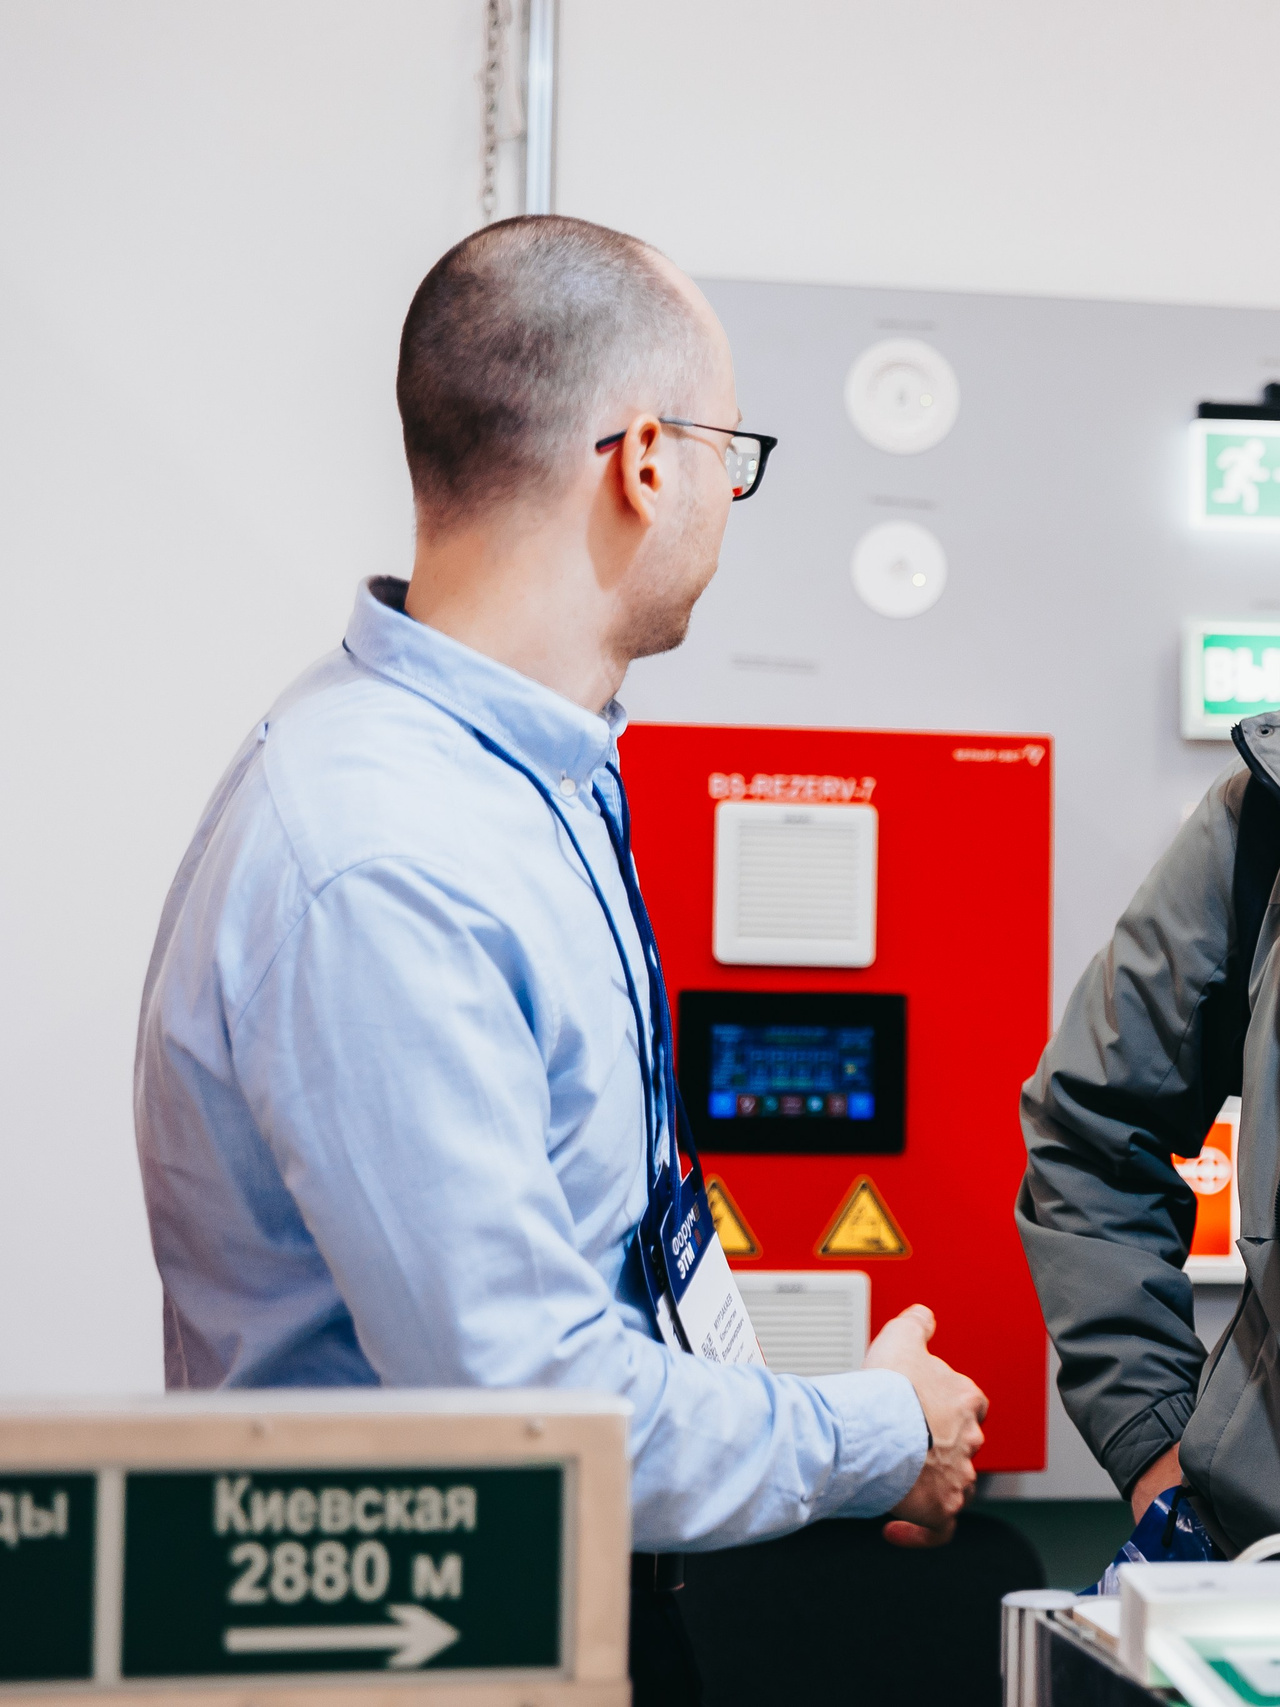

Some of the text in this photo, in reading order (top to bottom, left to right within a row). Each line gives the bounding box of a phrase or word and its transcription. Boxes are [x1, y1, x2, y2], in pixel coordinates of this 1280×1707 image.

[677, 1241, 696, 1280] ЭТМ
[213, 1476, 478, 1536] Киевская
[226, 1540, 464, 1605] 2880 м
